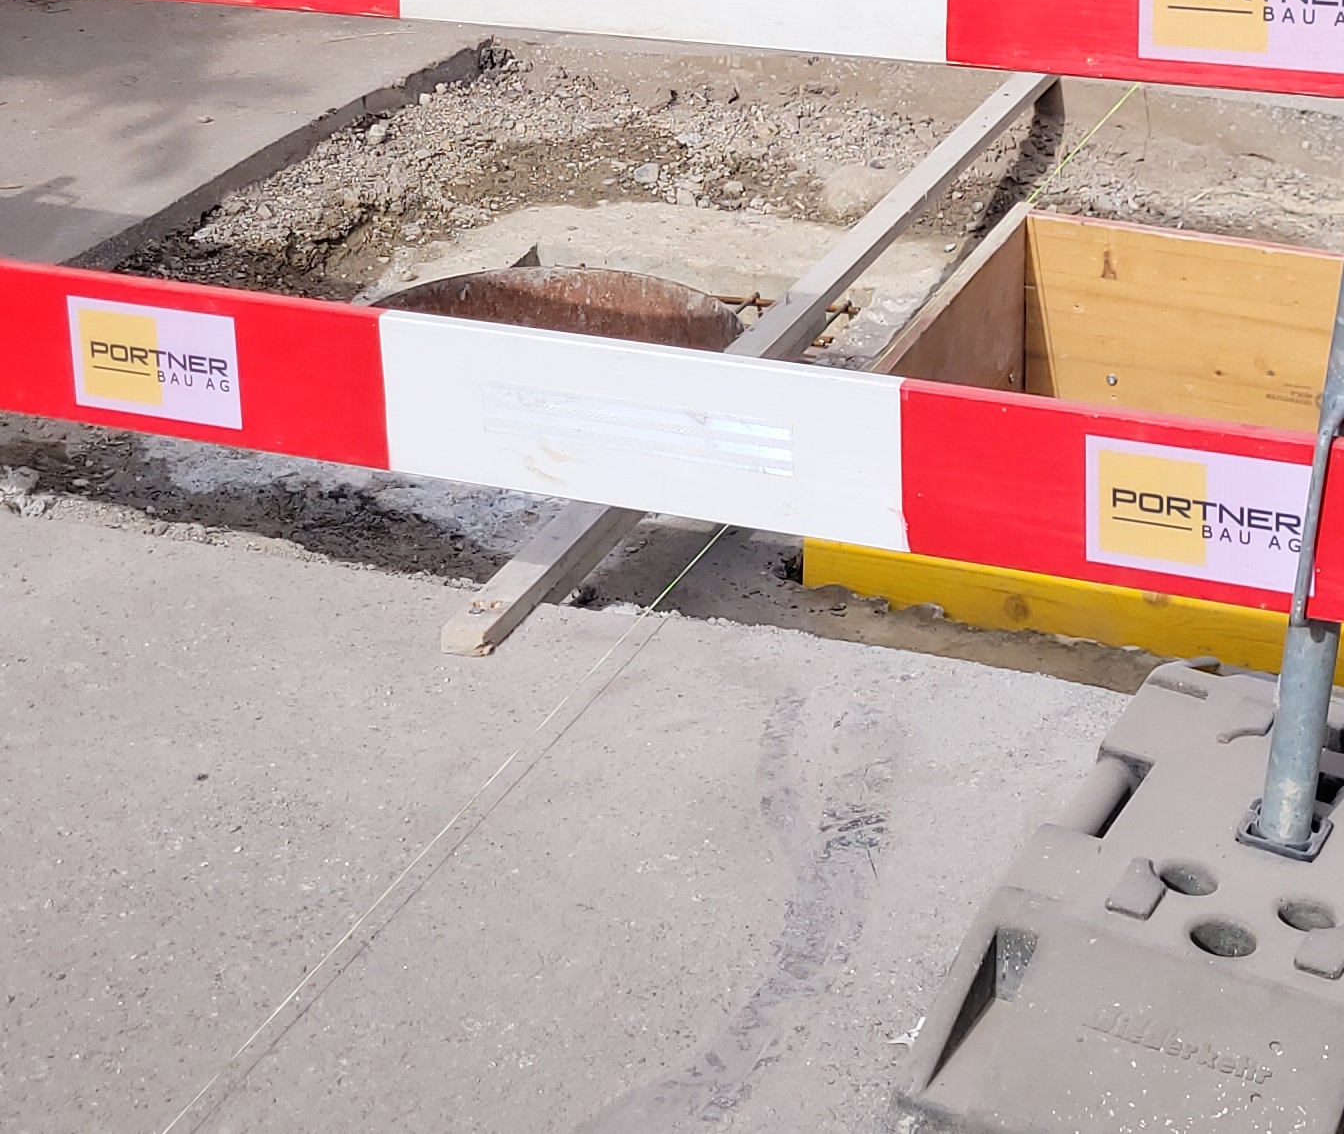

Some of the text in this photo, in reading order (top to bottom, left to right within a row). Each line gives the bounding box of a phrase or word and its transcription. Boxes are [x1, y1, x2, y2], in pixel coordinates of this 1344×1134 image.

[1262, 6, 1316, 25] BAU
[90, 340, 229, 378] PORTNER
[157, 370, 230, 393] BAU AG
[1112, 487, 1302, 536] PORTNER
[1201, 525, 1302, 553] BAU AG
